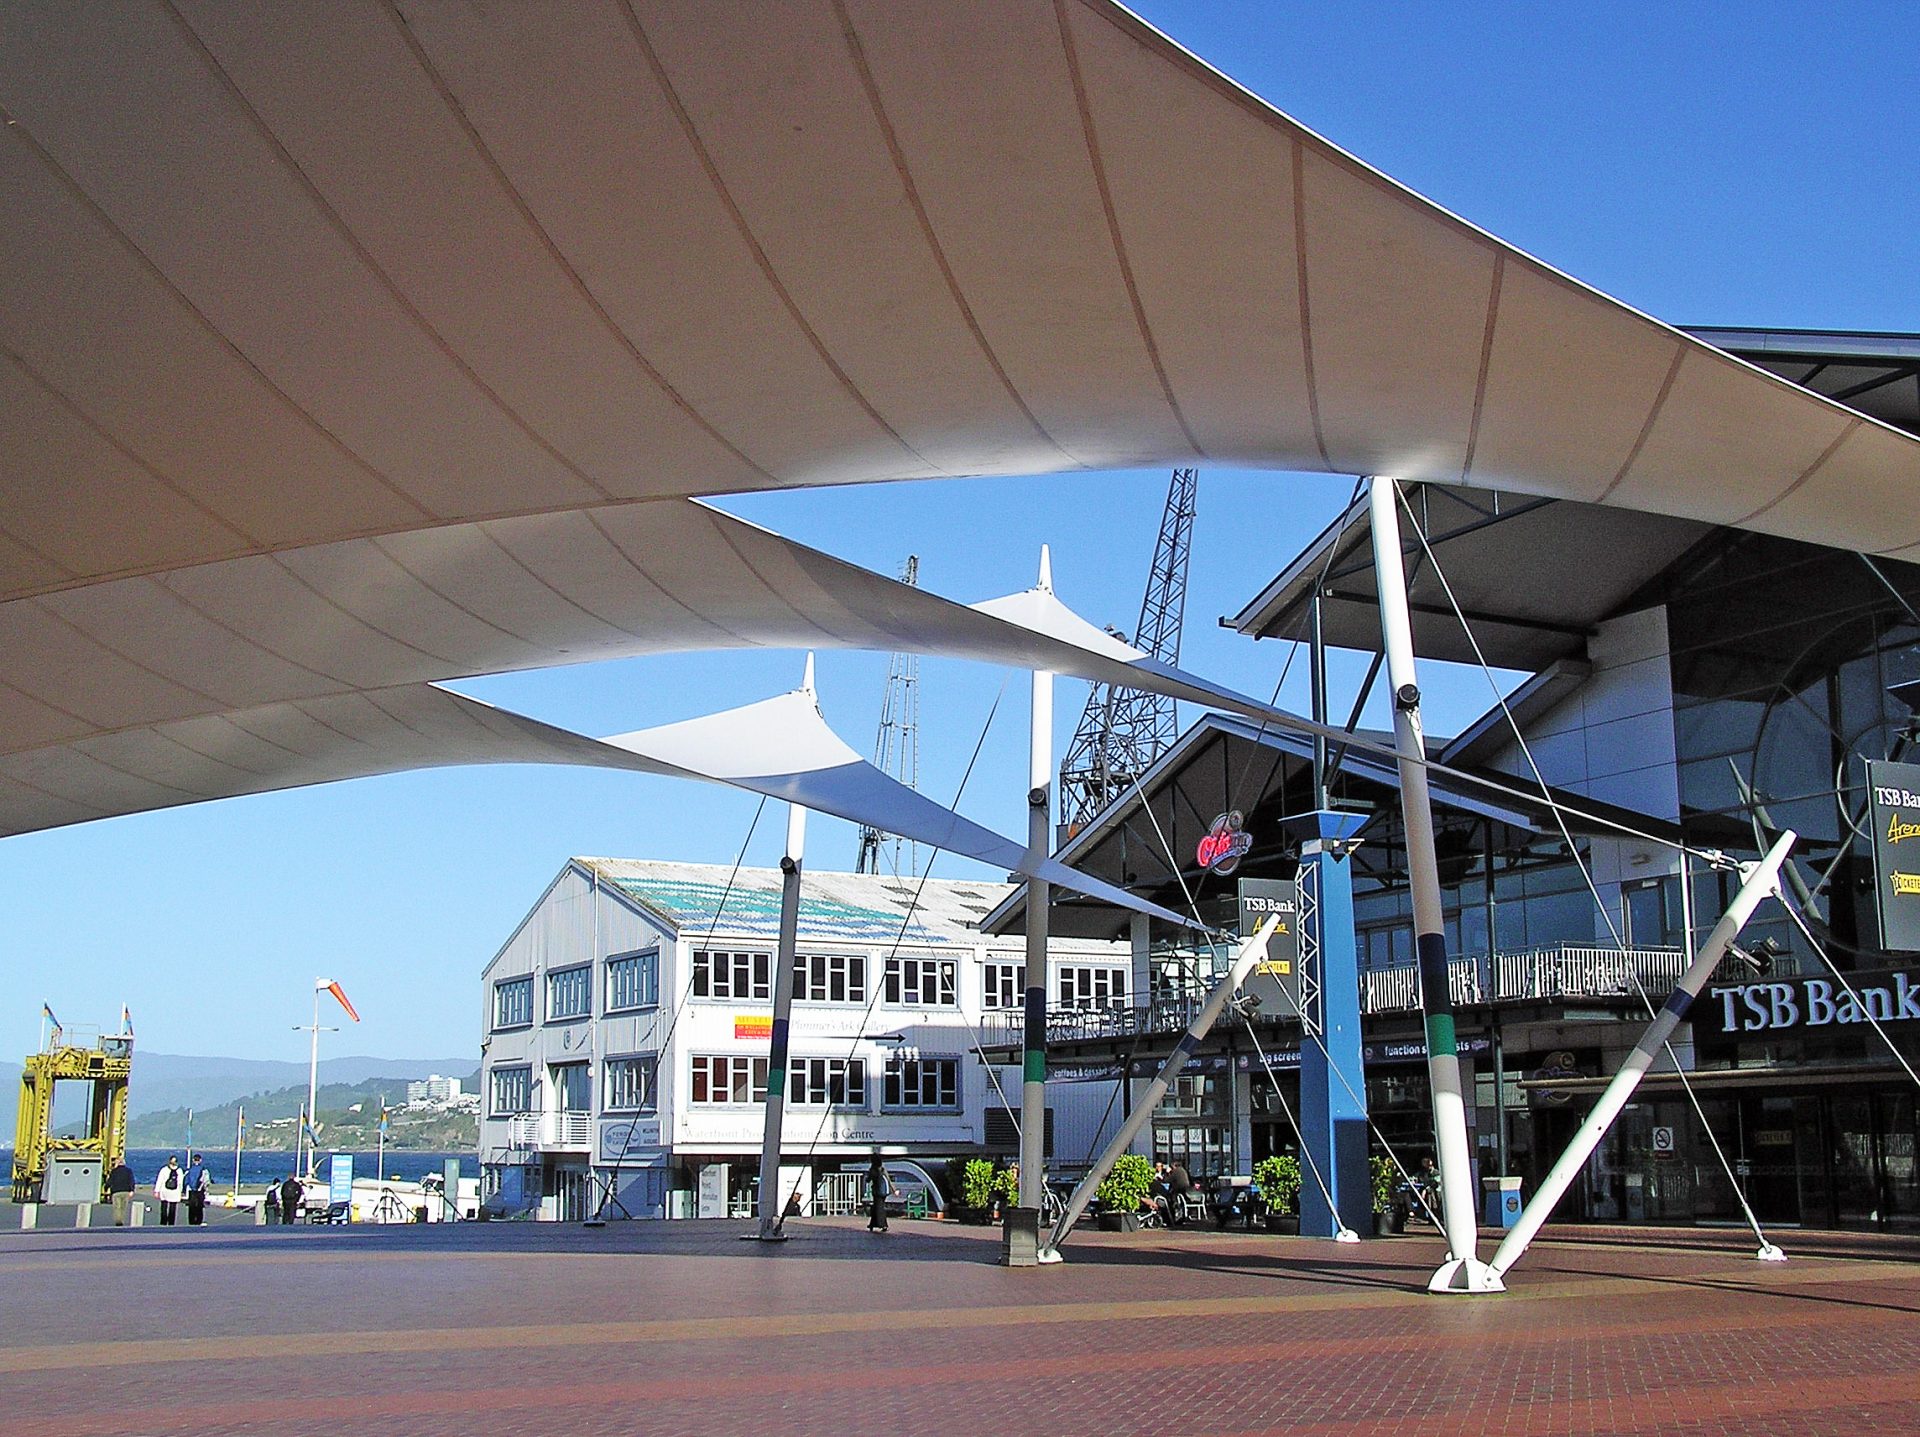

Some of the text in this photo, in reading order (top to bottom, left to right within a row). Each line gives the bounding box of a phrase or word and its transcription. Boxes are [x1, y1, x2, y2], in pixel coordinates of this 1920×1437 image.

[1875, 786, 1901, 806] TSB
[1243, 897, 1295, 913] TSB Bank
[1711, 973, 1920, 1032] TSB Bank
[1384, 1043, 1420, 1056] function
[842, 1128, 874, 1139] Centre
